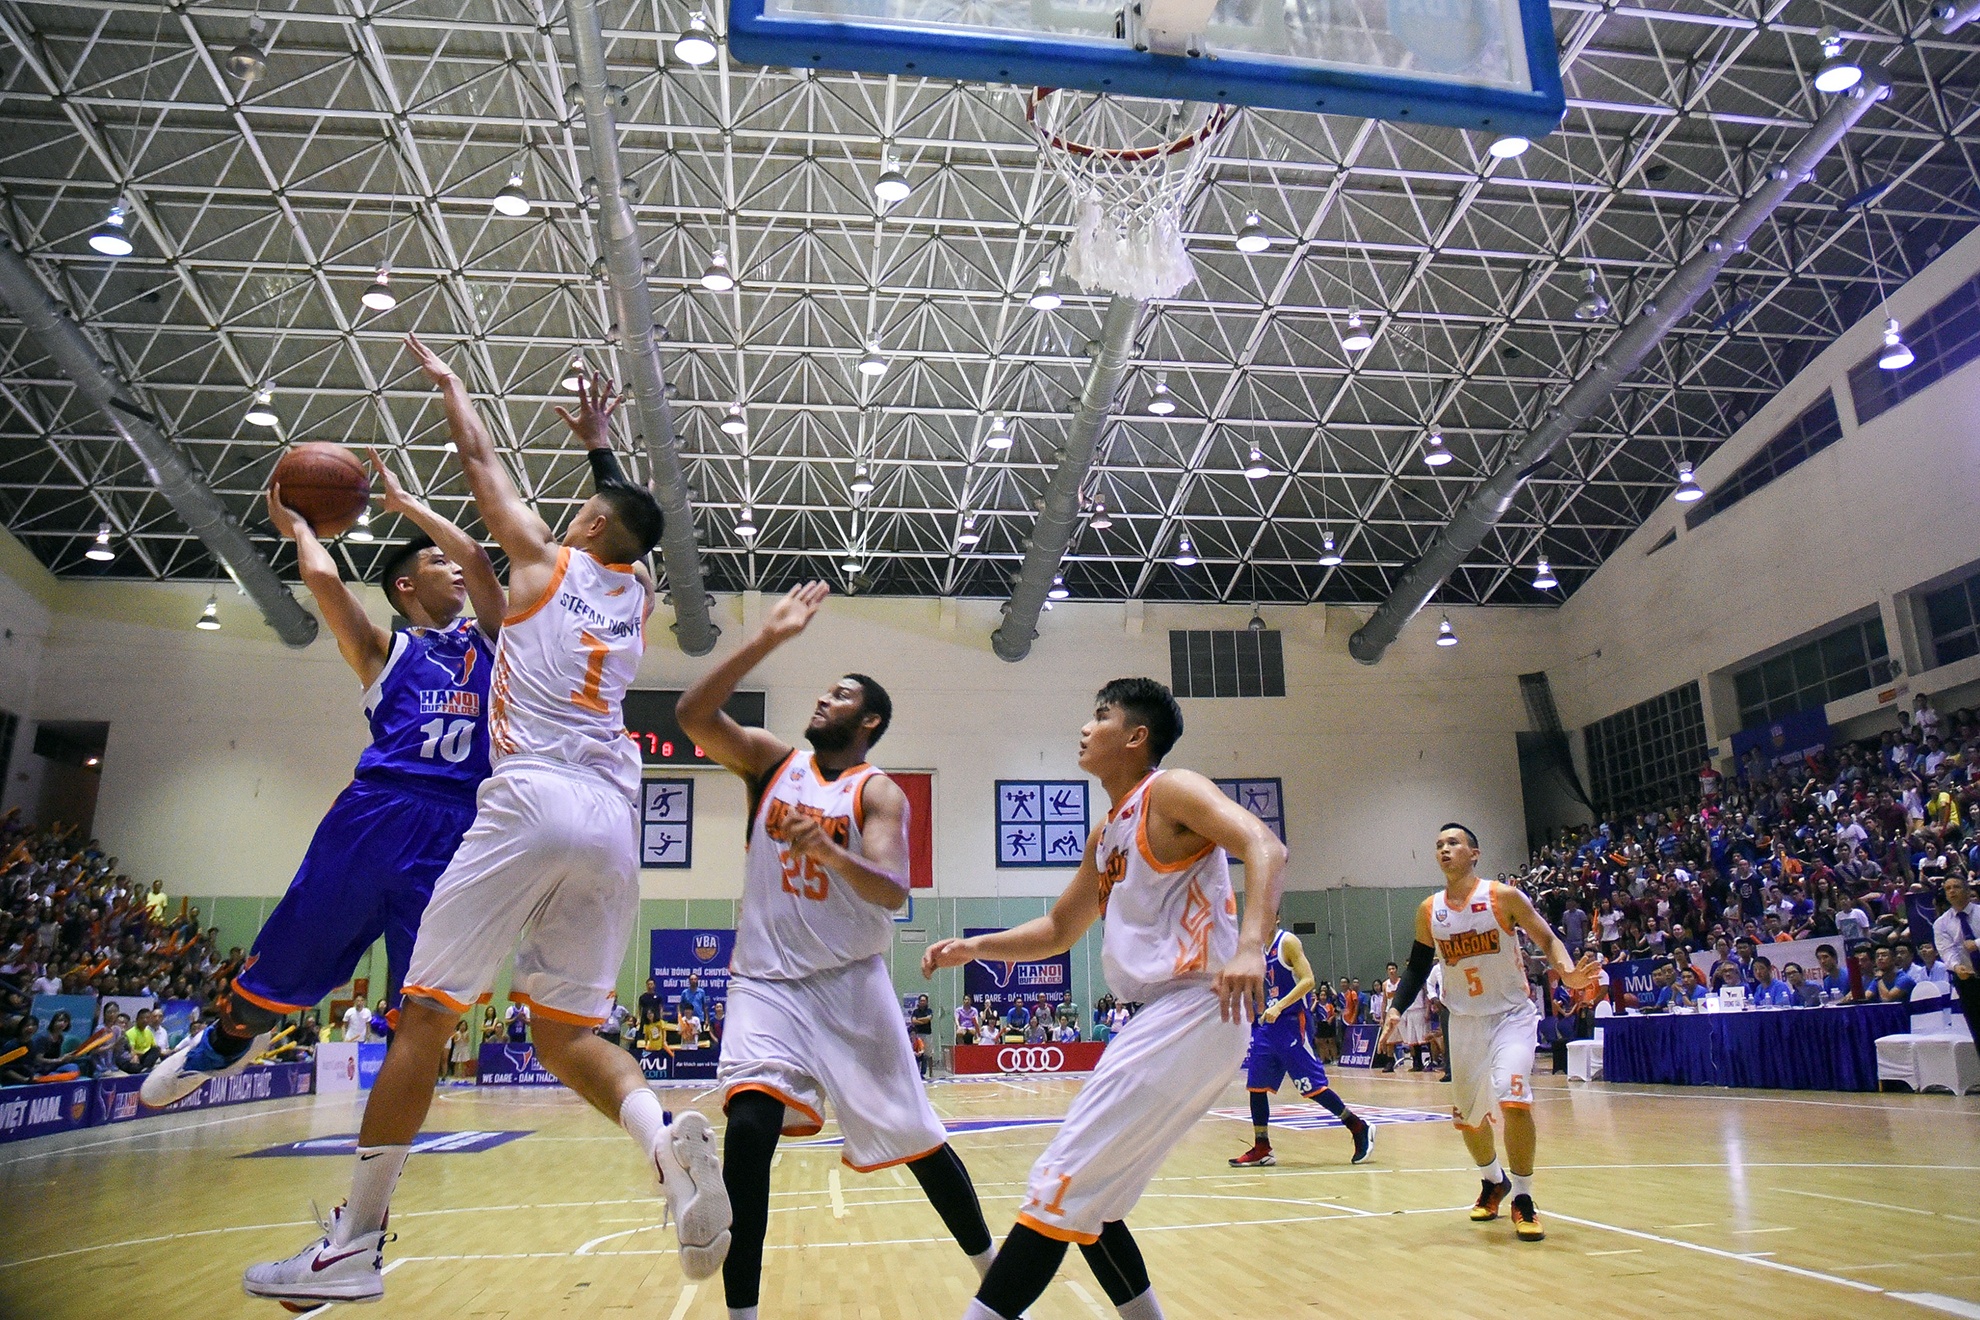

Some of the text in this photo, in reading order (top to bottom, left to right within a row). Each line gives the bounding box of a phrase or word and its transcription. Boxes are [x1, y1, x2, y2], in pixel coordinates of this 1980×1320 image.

[560, 593, 605, 627] STEFAN
[570, 630, 610, 716] 1
[421, 690, 479, 707] HANOI
[421, 704, 479, 716] BUFFALOES
[420, 718, 476, 763] 10
[779, 850, 829, 902] 25
[695, 935, 717, 948] VBA
[1019, 965, 1062, 977] HANOI
[1019, 976, 1062, 984] BUFFALOES
[1464, 966, 1484, 997] 5
[973, 994, 983, 1003] WE
[1023, 992, 1040, 1002] THÁC
[482, 1073, 493, 1084] WE
[494, 1073, 513, 1083] DARE
[1294, 1077, 1313, 1094] 23
[1511, 1074, 1523, 1096] 5
